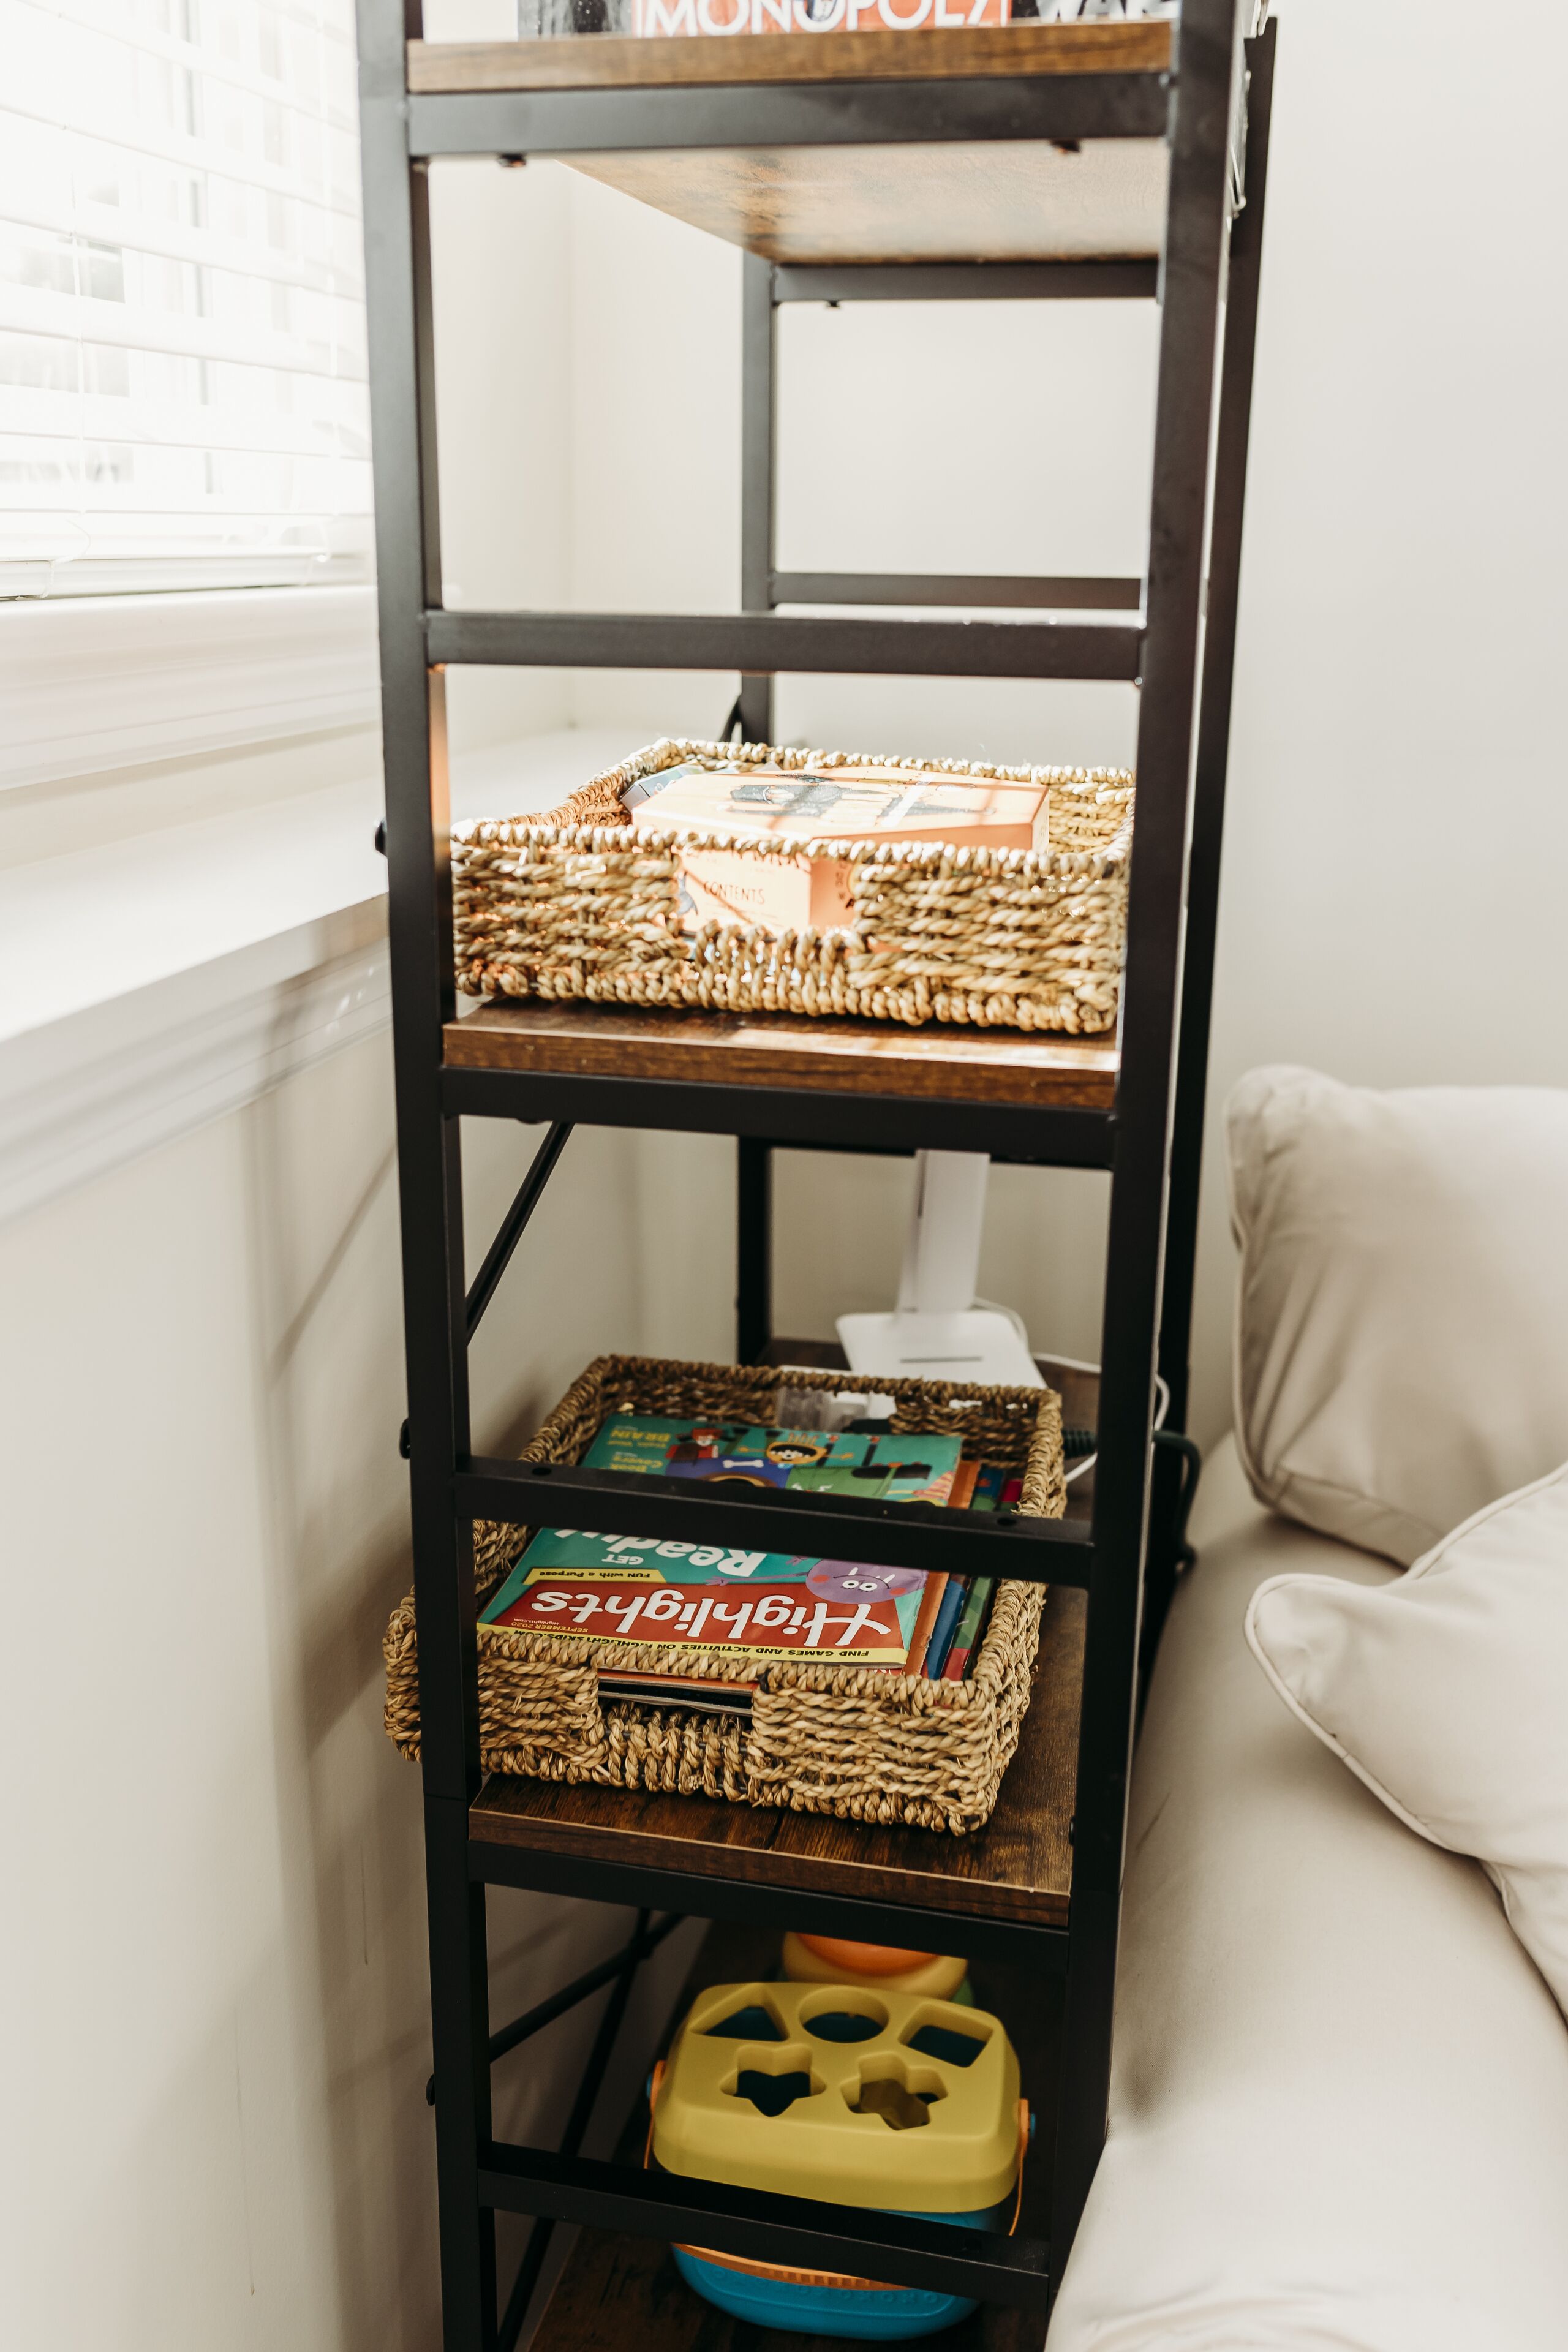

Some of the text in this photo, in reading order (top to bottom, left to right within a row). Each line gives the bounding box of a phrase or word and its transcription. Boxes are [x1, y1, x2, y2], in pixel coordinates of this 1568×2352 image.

[704, 881, 765, 905] CONTENTS
[601, 1554, 644, 1565] GET
[531, 1589, 891, 1647] Highlights
[535, 1624, 589, 1633] SEPTEMBER
[680, 1644, 751, 1653] ACTIVITIES
